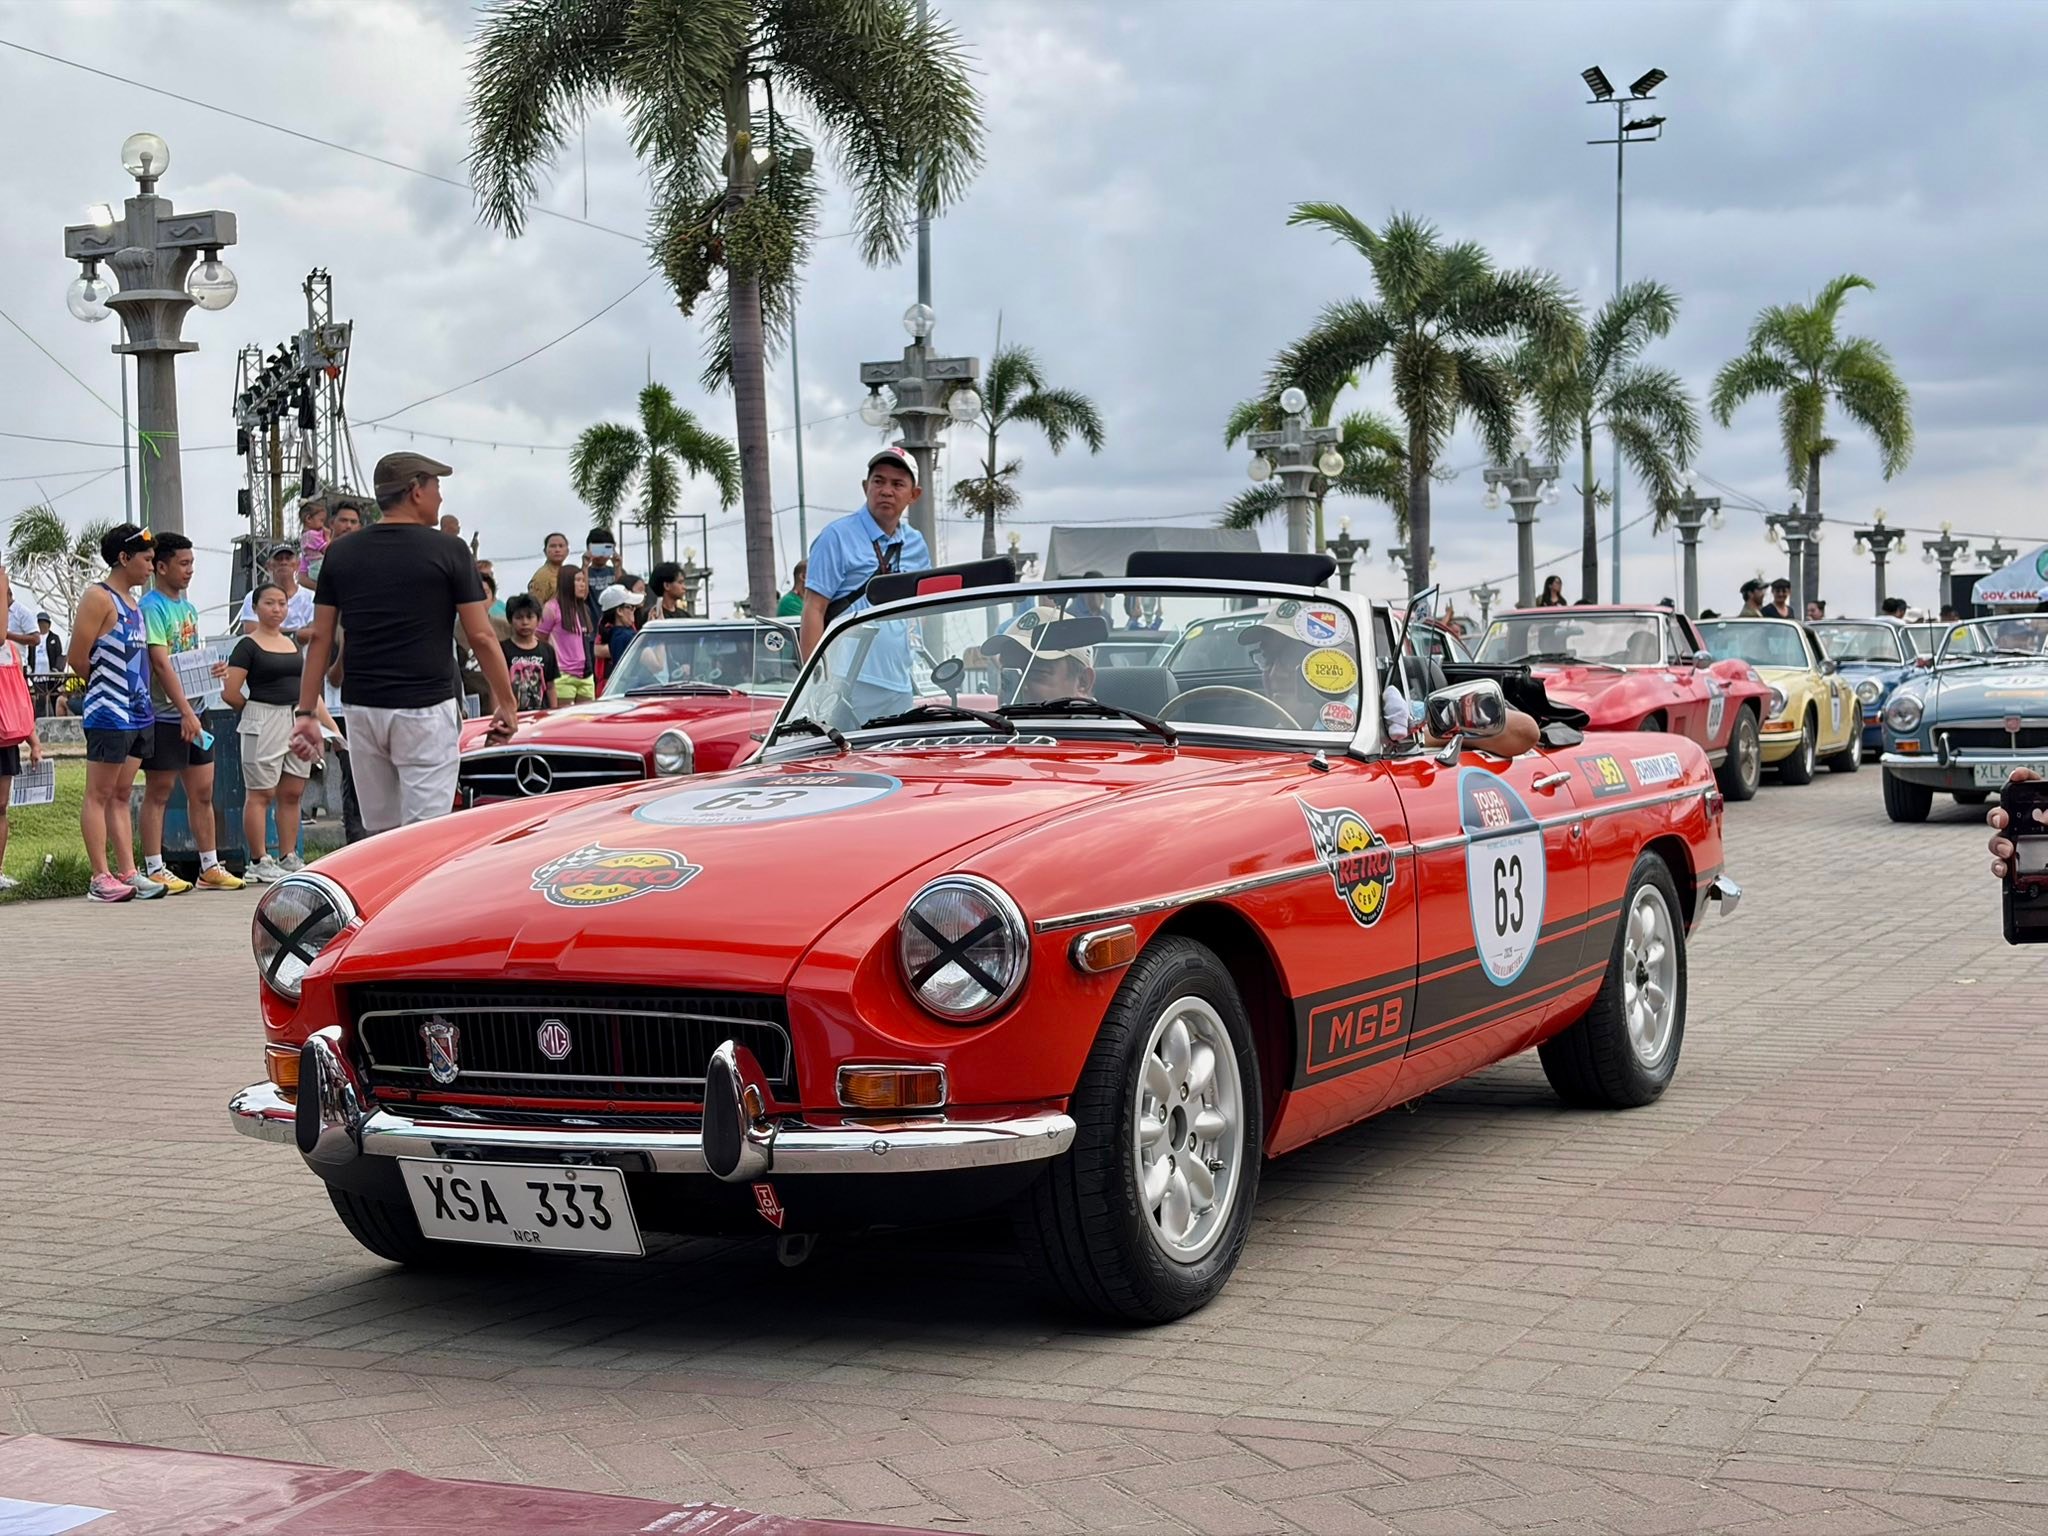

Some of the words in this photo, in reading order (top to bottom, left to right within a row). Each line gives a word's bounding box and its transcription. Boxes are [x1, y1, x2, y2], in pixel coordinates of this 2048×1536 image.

[1981, 591, 2007, 600] GOV.
[1278, 601, 1298, 617] MG
[1981, 765, 2007, 779] XLK
[691, 790, 808, 811] 63
[1473, 790, 1504, 810] TOUR
[1343, 827, 1363, 843] 103.5
[550, 869, 681, 884] RETRO
[1338, 850, 1391, 885] RETRO
[572, 887, 619, 895] CEBU
[1357, 887, 1377, 905] CEBU
[1493, 854, 1524, 938] 63
[1328, 997, 1403, 1054] MGB
[540, 1023, 569, 1056] MG
[422, 1175, 509, 1225] XSA
[526, 1181, 612, 1231] 333
[759, 1189, 777, 1216] TOW
[512, 1229, 542, 1243] NCR
